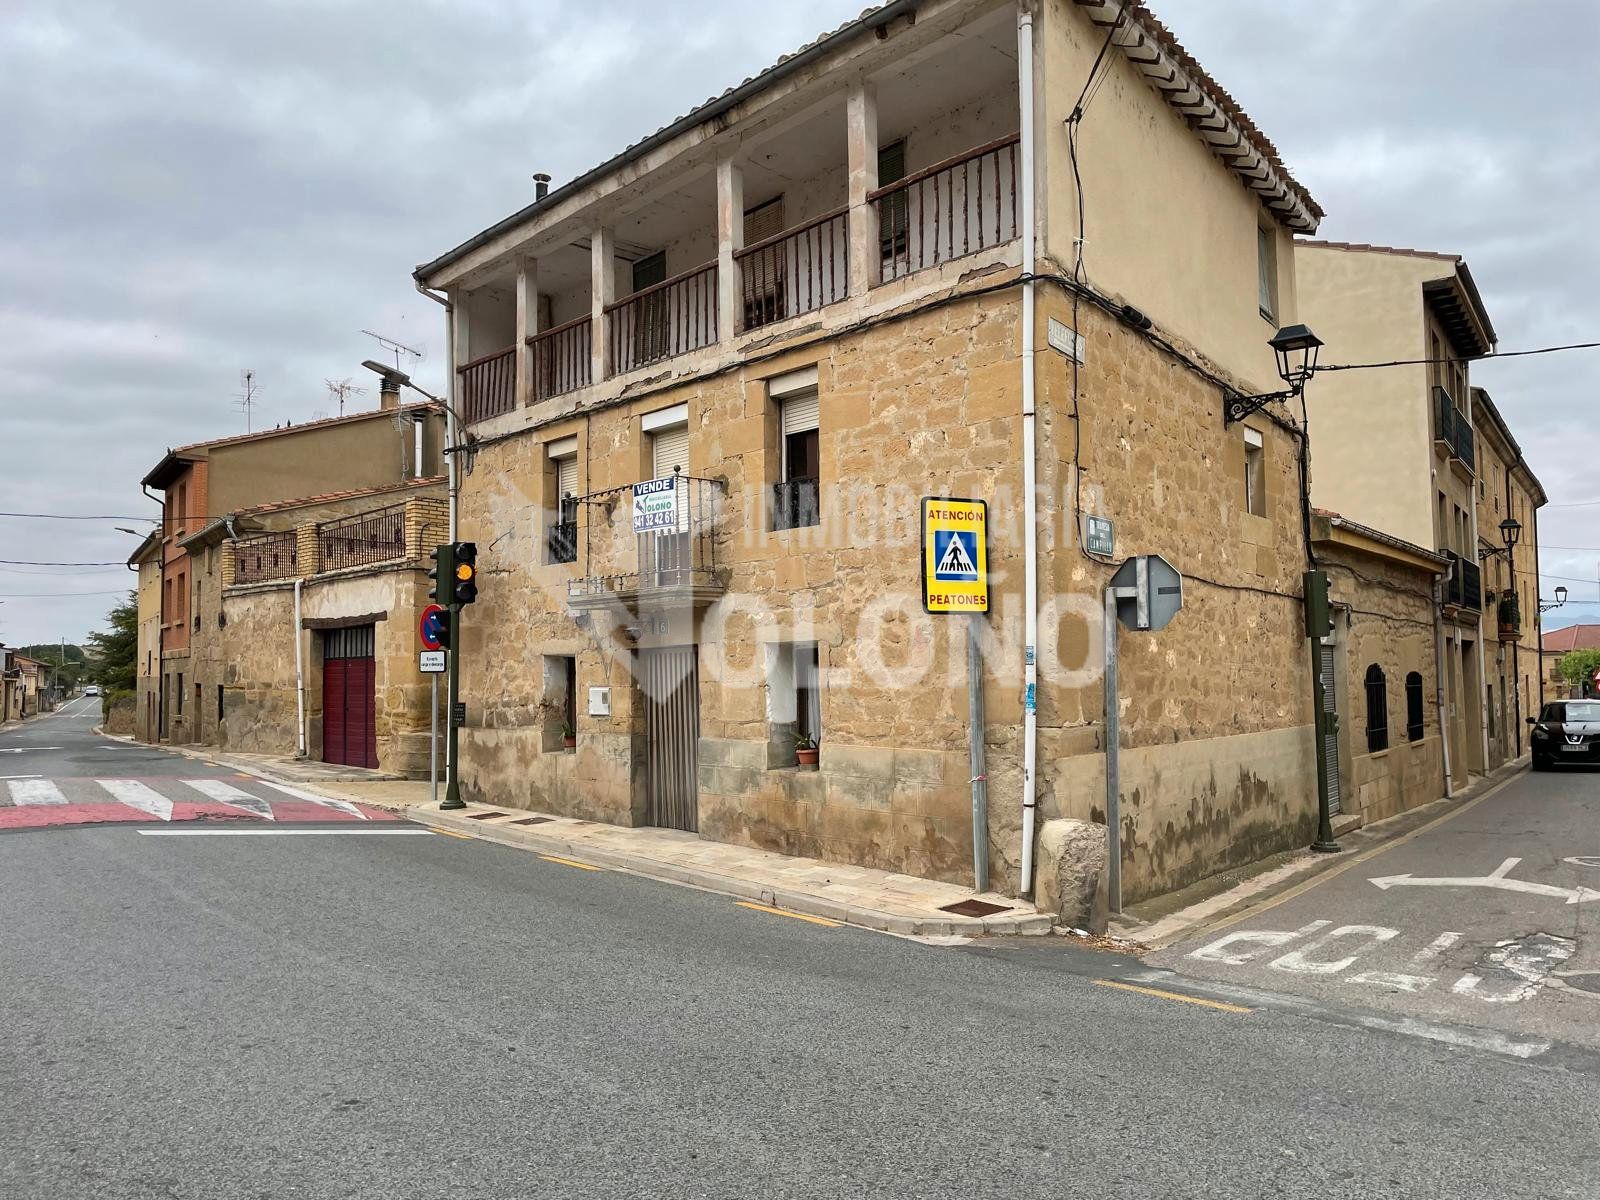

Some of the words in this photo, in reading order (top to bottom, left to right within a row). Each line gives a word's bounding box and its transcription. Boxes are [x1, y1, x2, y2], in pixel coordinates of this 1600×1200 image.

[637, 480, 670, 494] VENDE
[645, 514, 654, 526] 32
[655, 512, 663, 524] 42
[664, 511, 674, 523] 61
[928, 510, 983, 521] ATENCIÓN
[930, 594, 987, 605] PEATONES
